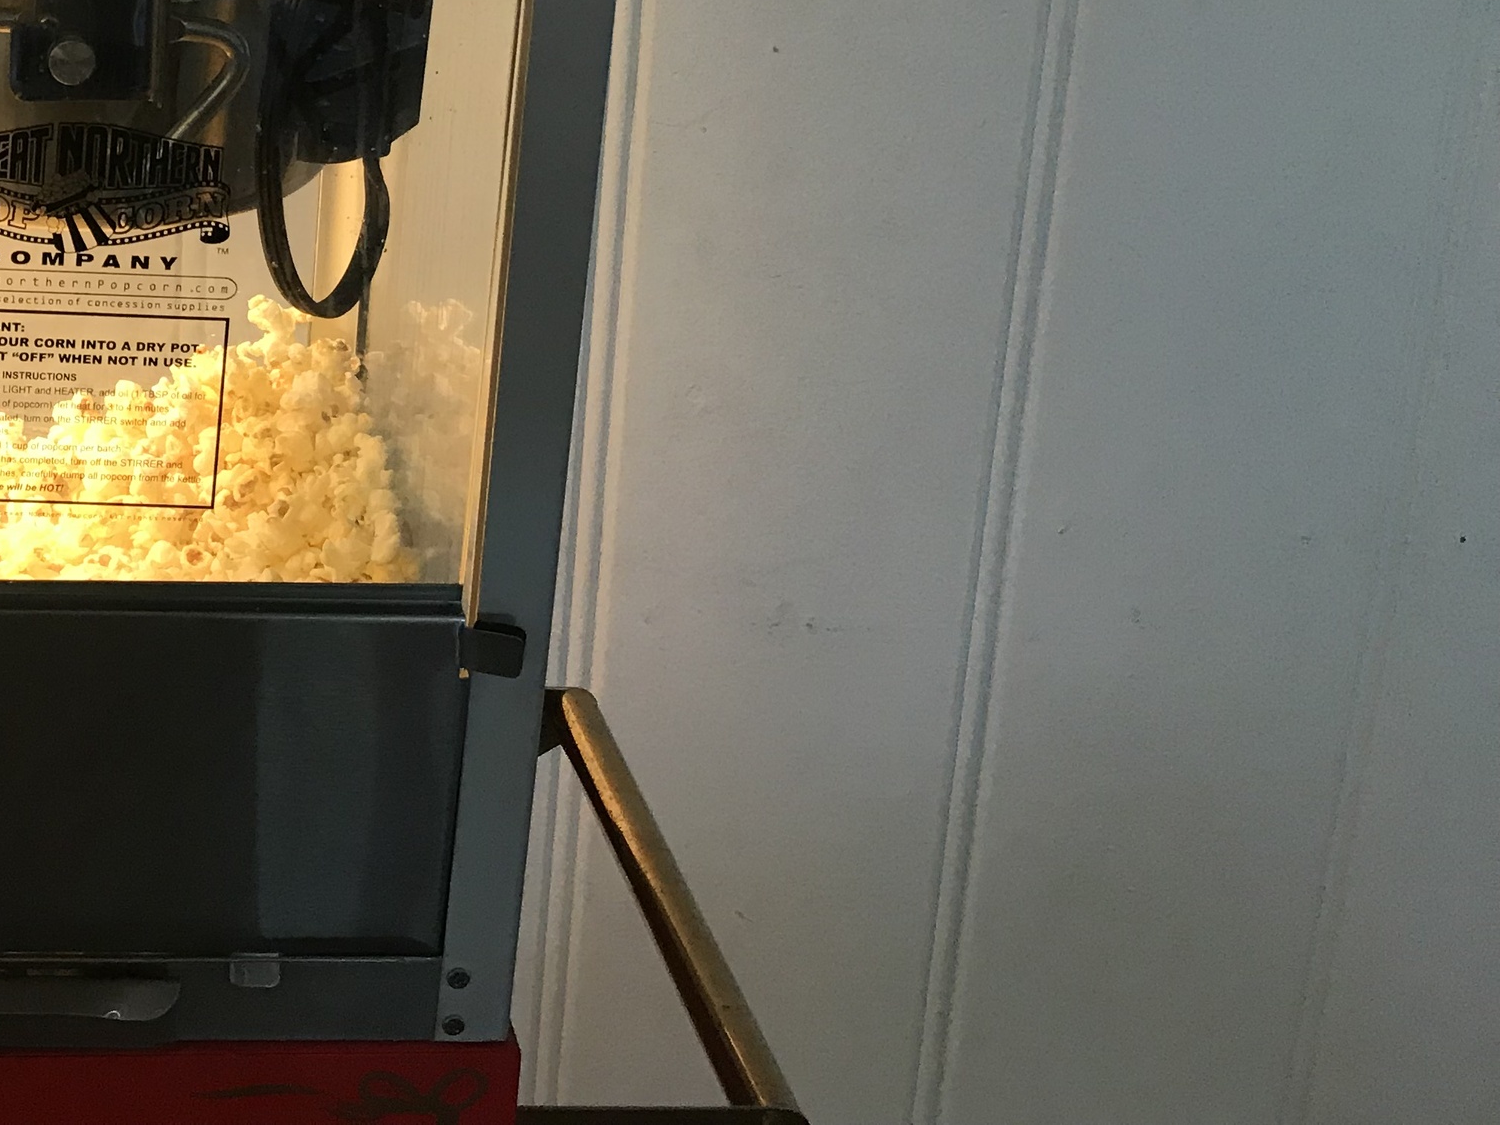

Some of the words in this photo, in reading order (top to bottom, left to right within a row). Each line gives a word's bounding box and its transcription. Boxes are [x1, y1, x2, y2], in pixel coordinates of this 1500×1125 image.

[55, 122, 225, 190] NORTHERN
[113, 190, 228, 235] CORN
[67, 298, 81, 306] of
[87, 299, 161, 309] concession
[167, 302, 226, 312] supplies
[34, 338, 76, 349] CORN
[81, 340, 117, 351] INTO
[121, 341, 132, 351] A
[136, 342, 167, 352] DRY
[58, 353, 103, 364] WHEN
[107, 355, 139, 366] NOT
[143, 357, 158, 367] IN
[163, 358, 197, 368] USE.
[2, 371, 78, 382] INSTRUCTIONS
[2, 385, 33, 394] LIGHT
[34, 386, 52, 394] and
[98, 388, 116, 397] add
[117, 389, 129, 397] oil
[142, 389, 169, 399] TBSP
[170, 391, 180, 399] of
[181, 391, 193, 400] oil
[2, 398, 11, 407] of
[92, 403, 105, 411] for
[115, 403, 124, 411] to
[24, 414, 41, 423] turn
[57, 415, 71, 424] the
[74, 416, 118, 425] STIRRER
[120, 417, 148, 426] switch
[150, 418, 167, 427] and
[169, 419, 187, 428] add
[12, 443, 28, 452] cup
[30, 442, 40, 451] of
[41, 443, 78, 452] popcorn
[80, 445, 95, 453] per
[0, 455, 17, 463] has
[70, 458, 88, 466] turn
[89, 458, 102, 466] off
[103, 458, 118, 467] the
[120, 458, 164, 468] STIRRER
[165, 460, 183, 469] and
[20, 469, 59, 480] carefully
[60, 471, 86, 481] dump
[87, 471, 98, 480] all
[100, 473, 136, 482] popcorn
[138, 473, 159, 482] from
[160, 474, 175, 483] the
[6, 482, 23, 491] will
[25, 483, 38, 492] be
[39, 483, 65, 493] HOT!
